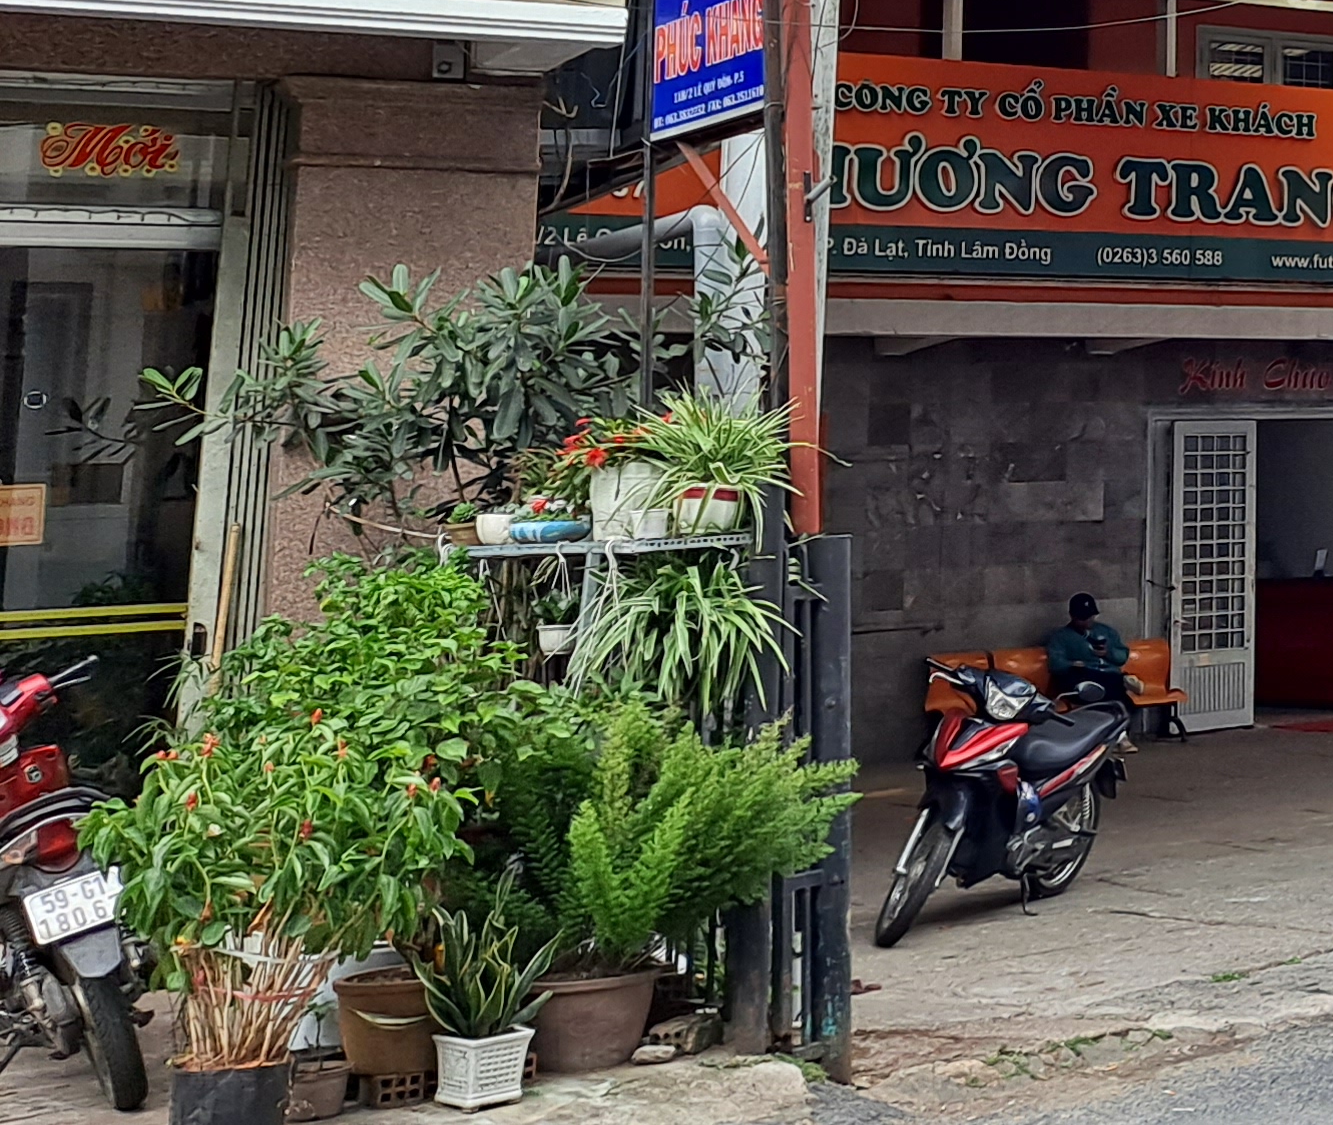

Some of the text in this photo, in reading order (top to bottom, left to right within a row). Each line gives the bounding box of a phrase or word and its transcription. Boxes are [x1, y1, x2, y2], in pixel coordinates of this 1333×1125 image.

[654, 0, 702, 84] PHÚC
[836, 78, 1317, 140] CÔNG TY CỔ PHẦN XE KHÁCH
[829, 131, 1097, 217] ƯƠNG
[874, 238, 909, 261] Lạt,
[961, 240, 999, 259] Lâm
[1004, 239, 1051, 264] Đồng
[1097, 247, 1223, 267] (0263)3 560 588
[40, 877, 106, 914] 59-G1
